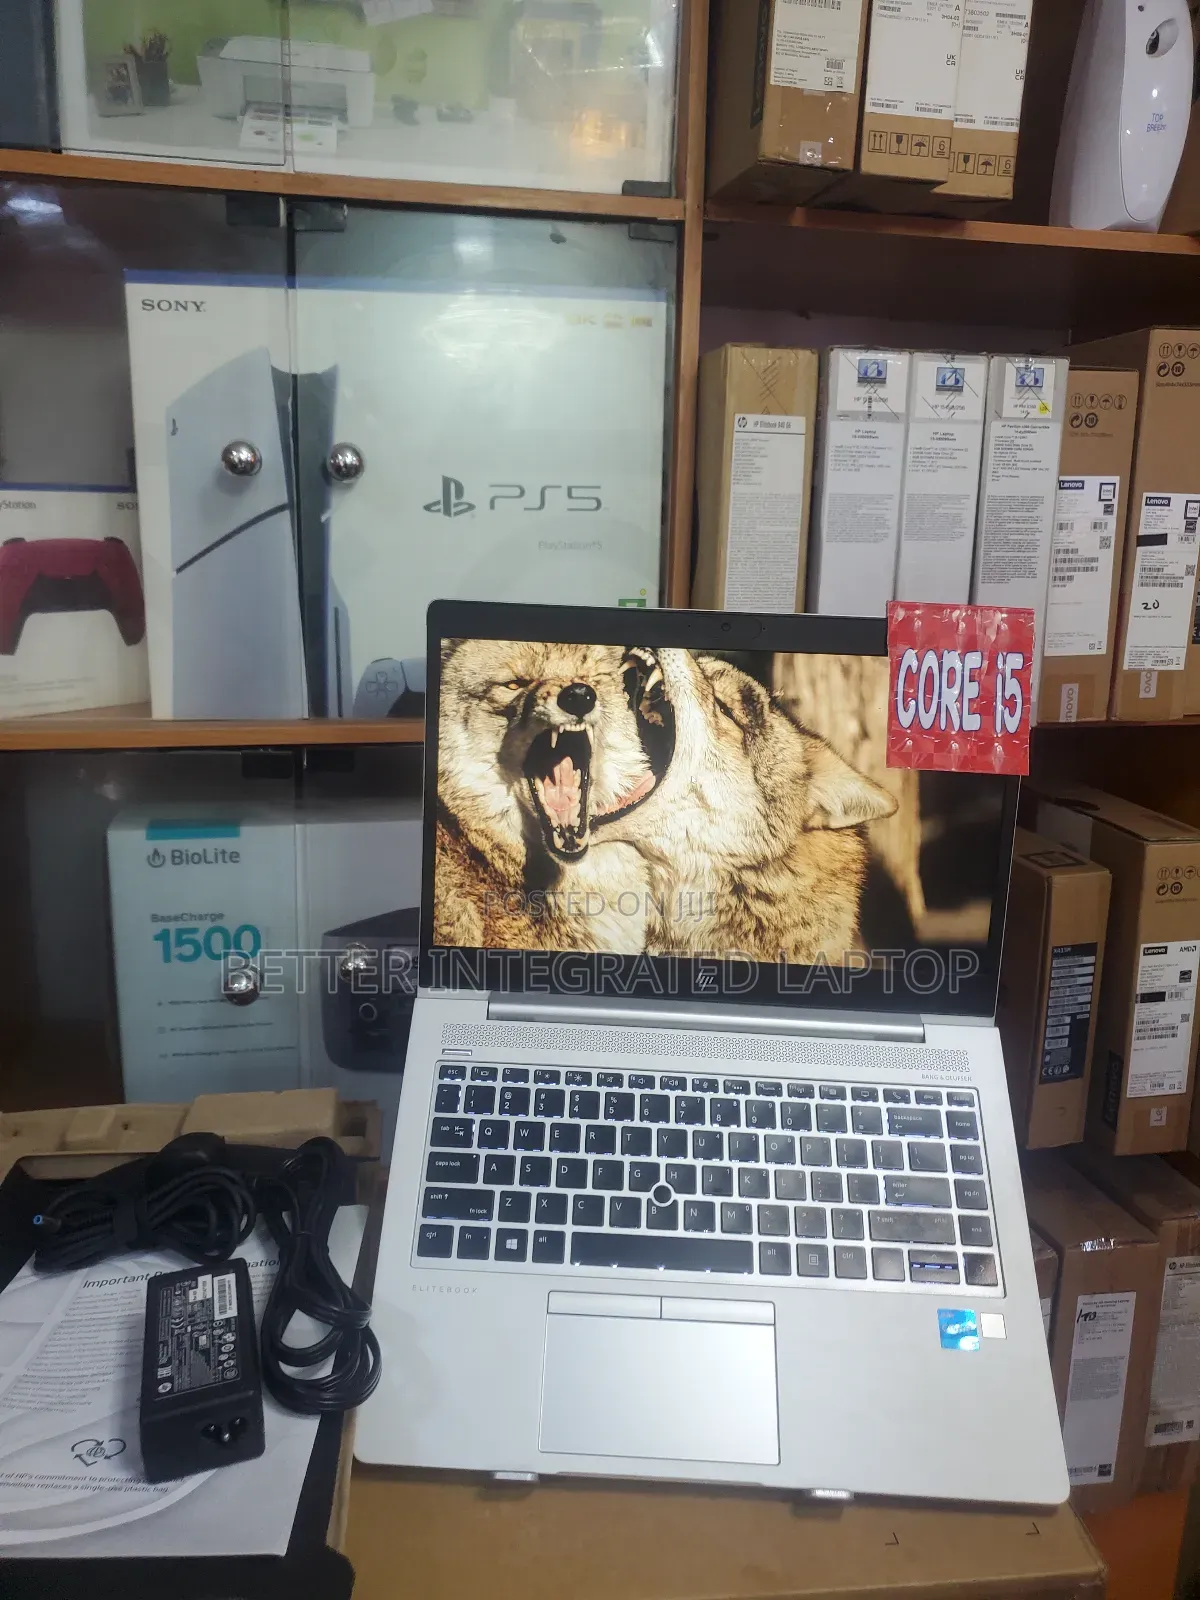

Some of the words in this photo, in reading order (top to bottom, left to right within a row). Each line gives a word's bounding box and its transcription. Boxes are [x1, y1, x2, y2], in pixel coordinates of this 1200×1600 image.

[1152, 113, 1163, 122] TOP
[141, 298, 206, 312] SONY
[489, 484, 602, 512] PS5
[1141, 599, 1160, 610] 20
[895, 648, 983, 732] CORE
[171, 848, 240, 866] BioLite
[151, 911, 225, 923] BaseCharge
[153, 925, 261, 964] 1500
[484, 1127, 492, 1136] Q
[520, 1129, 529, 1137] W
[771, 1142, 778, 1150] O
[490, 1163, 497, 1171] A
[561, 1166, 568, 1174] D
[634, 1169, 641, 1177] G
[505, 1198, 512, 1206] Z
[541, 1199, 548, 1207] X
[578, 1200, 584, 1209] C
[615, 1202, 622, 1210] V
[690, 1208, 697, 1216] N
[727, 1211, 735, 1219] M
[83, 1273, 150, 1288] Important
[412, 1284, 478, 1294] ELITEBOOK
[34, 1474, 87, 1482] commitment
[79, 1484, 122, 1492] single-use
